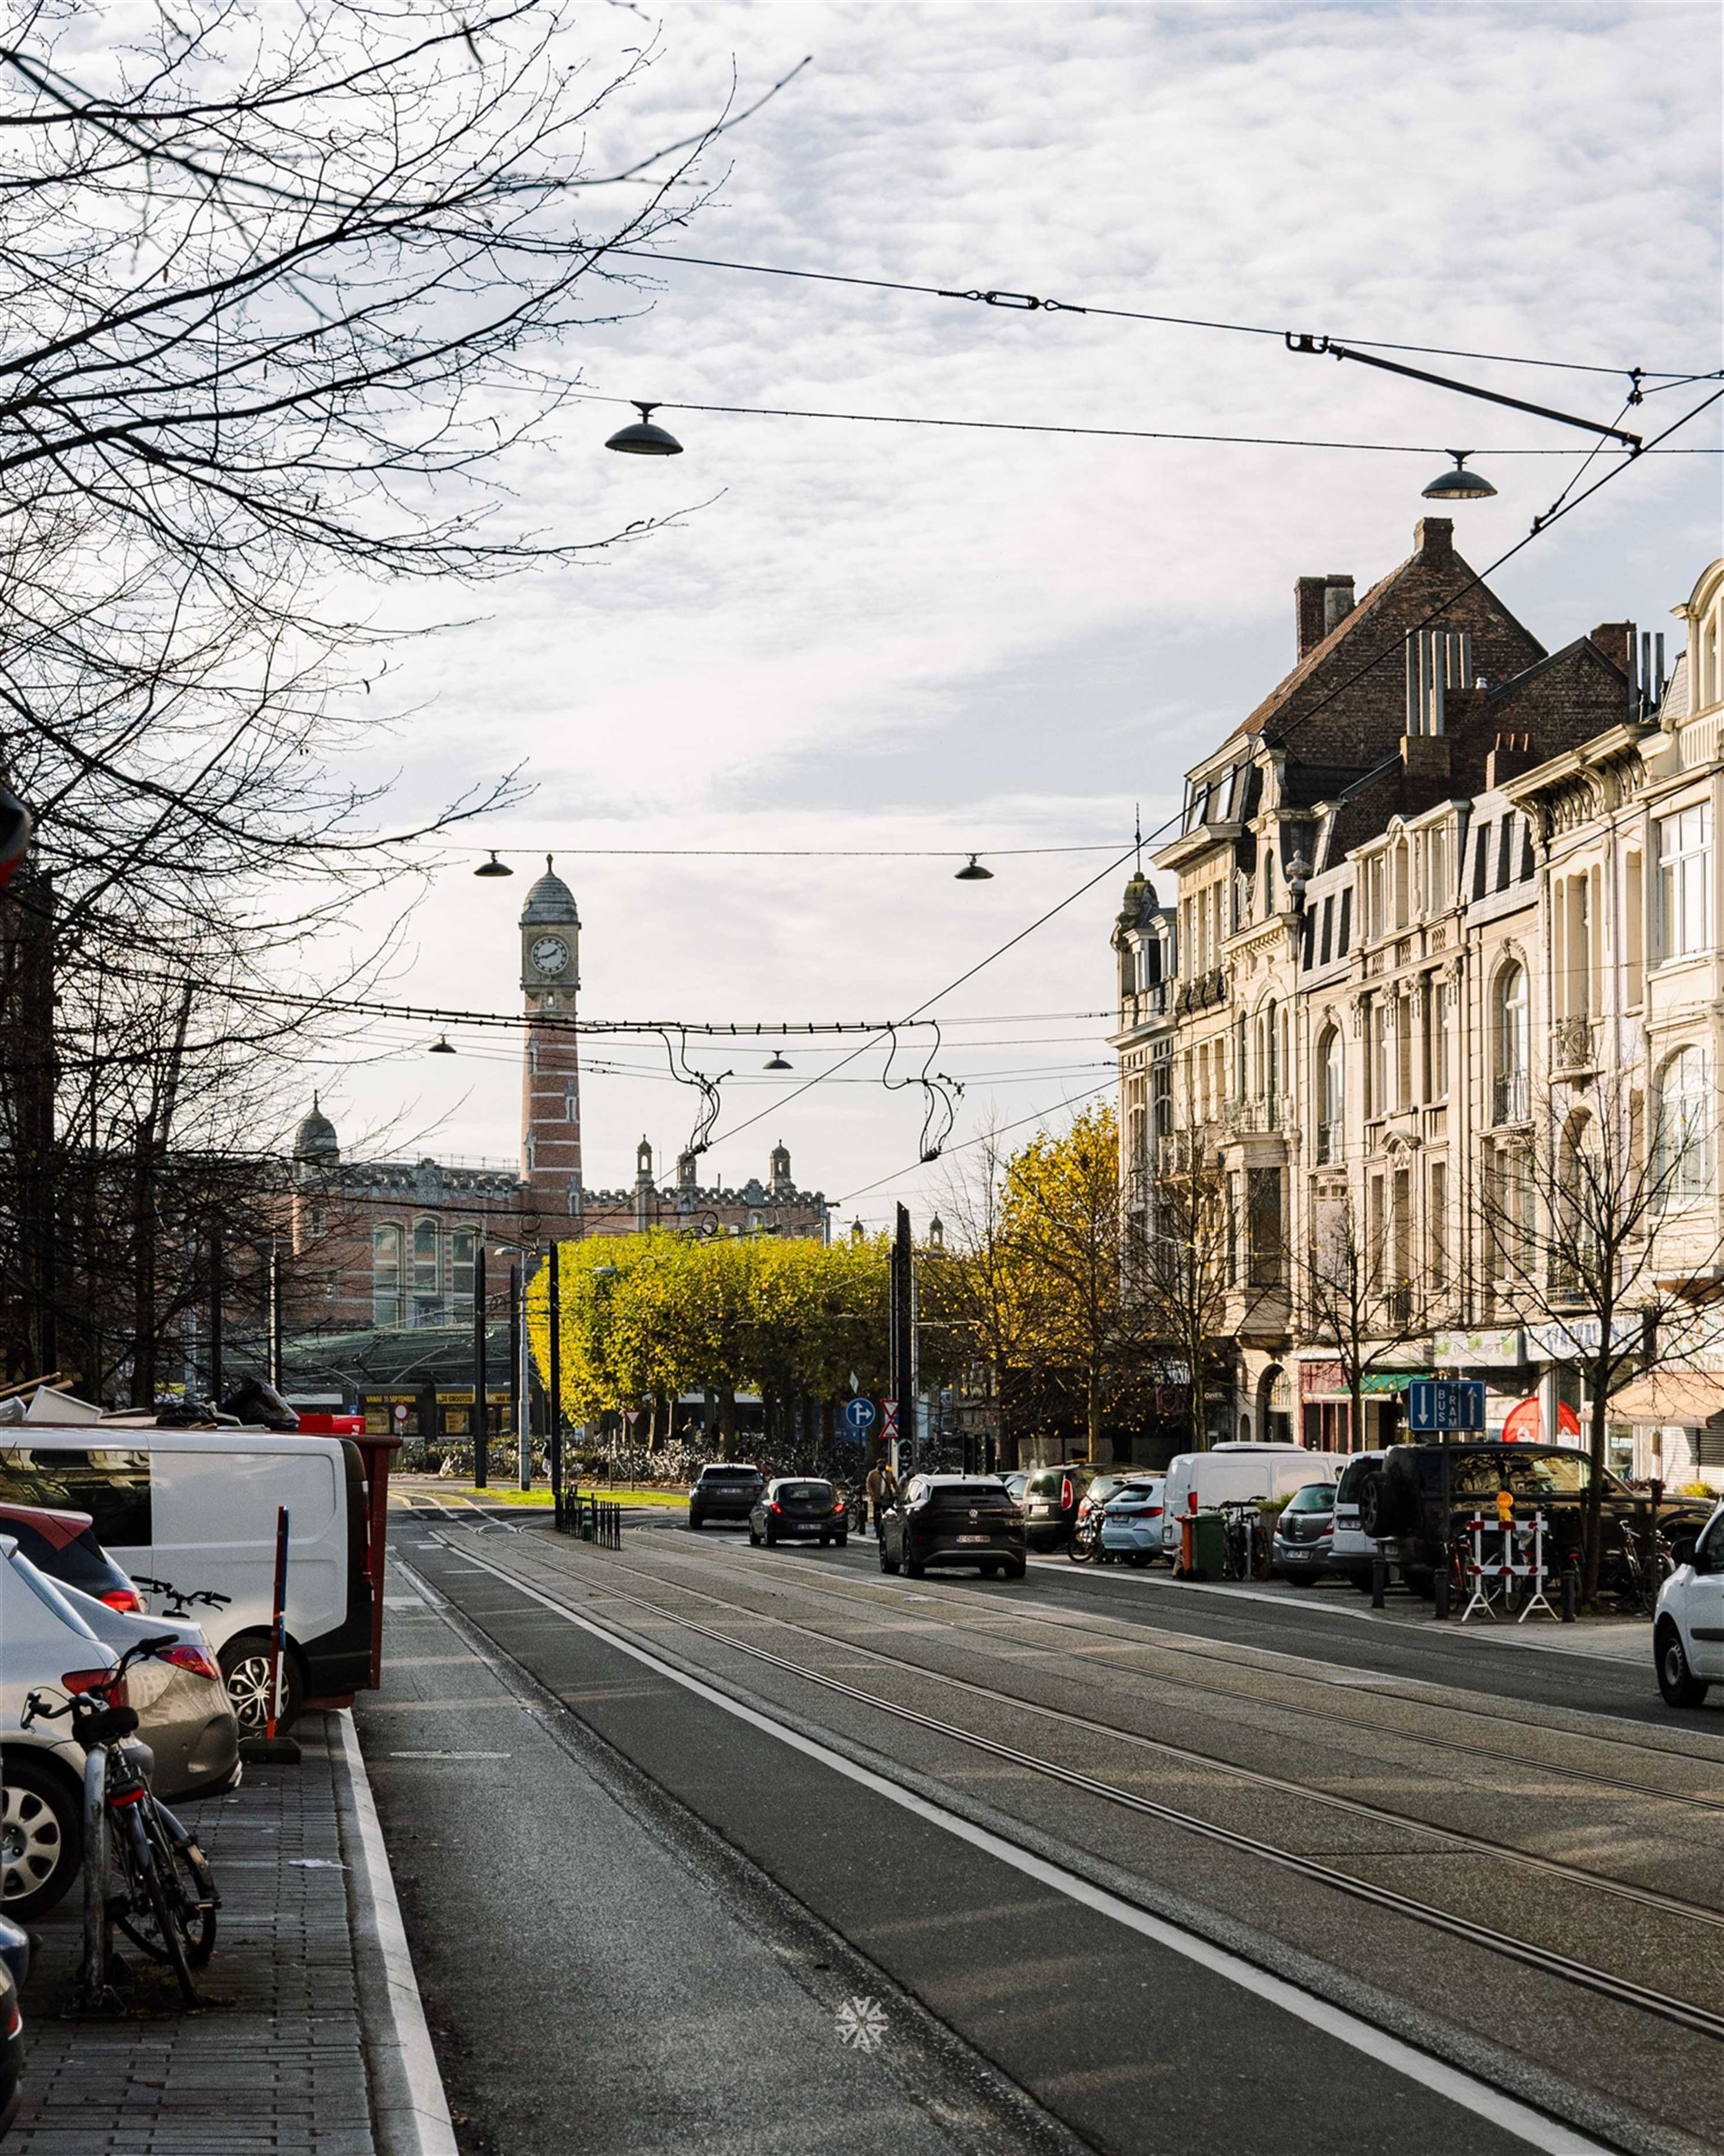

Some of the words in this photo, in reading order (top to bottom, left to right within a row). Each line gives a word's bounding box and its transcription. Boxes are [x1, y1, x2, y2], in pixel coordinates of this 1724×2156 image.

[389, 1395, 417, 1403] SEPTEMBER
[1438, 1389, 1446, 1422] BUS
[1448, 1384, 1457, 1427] TRAM
